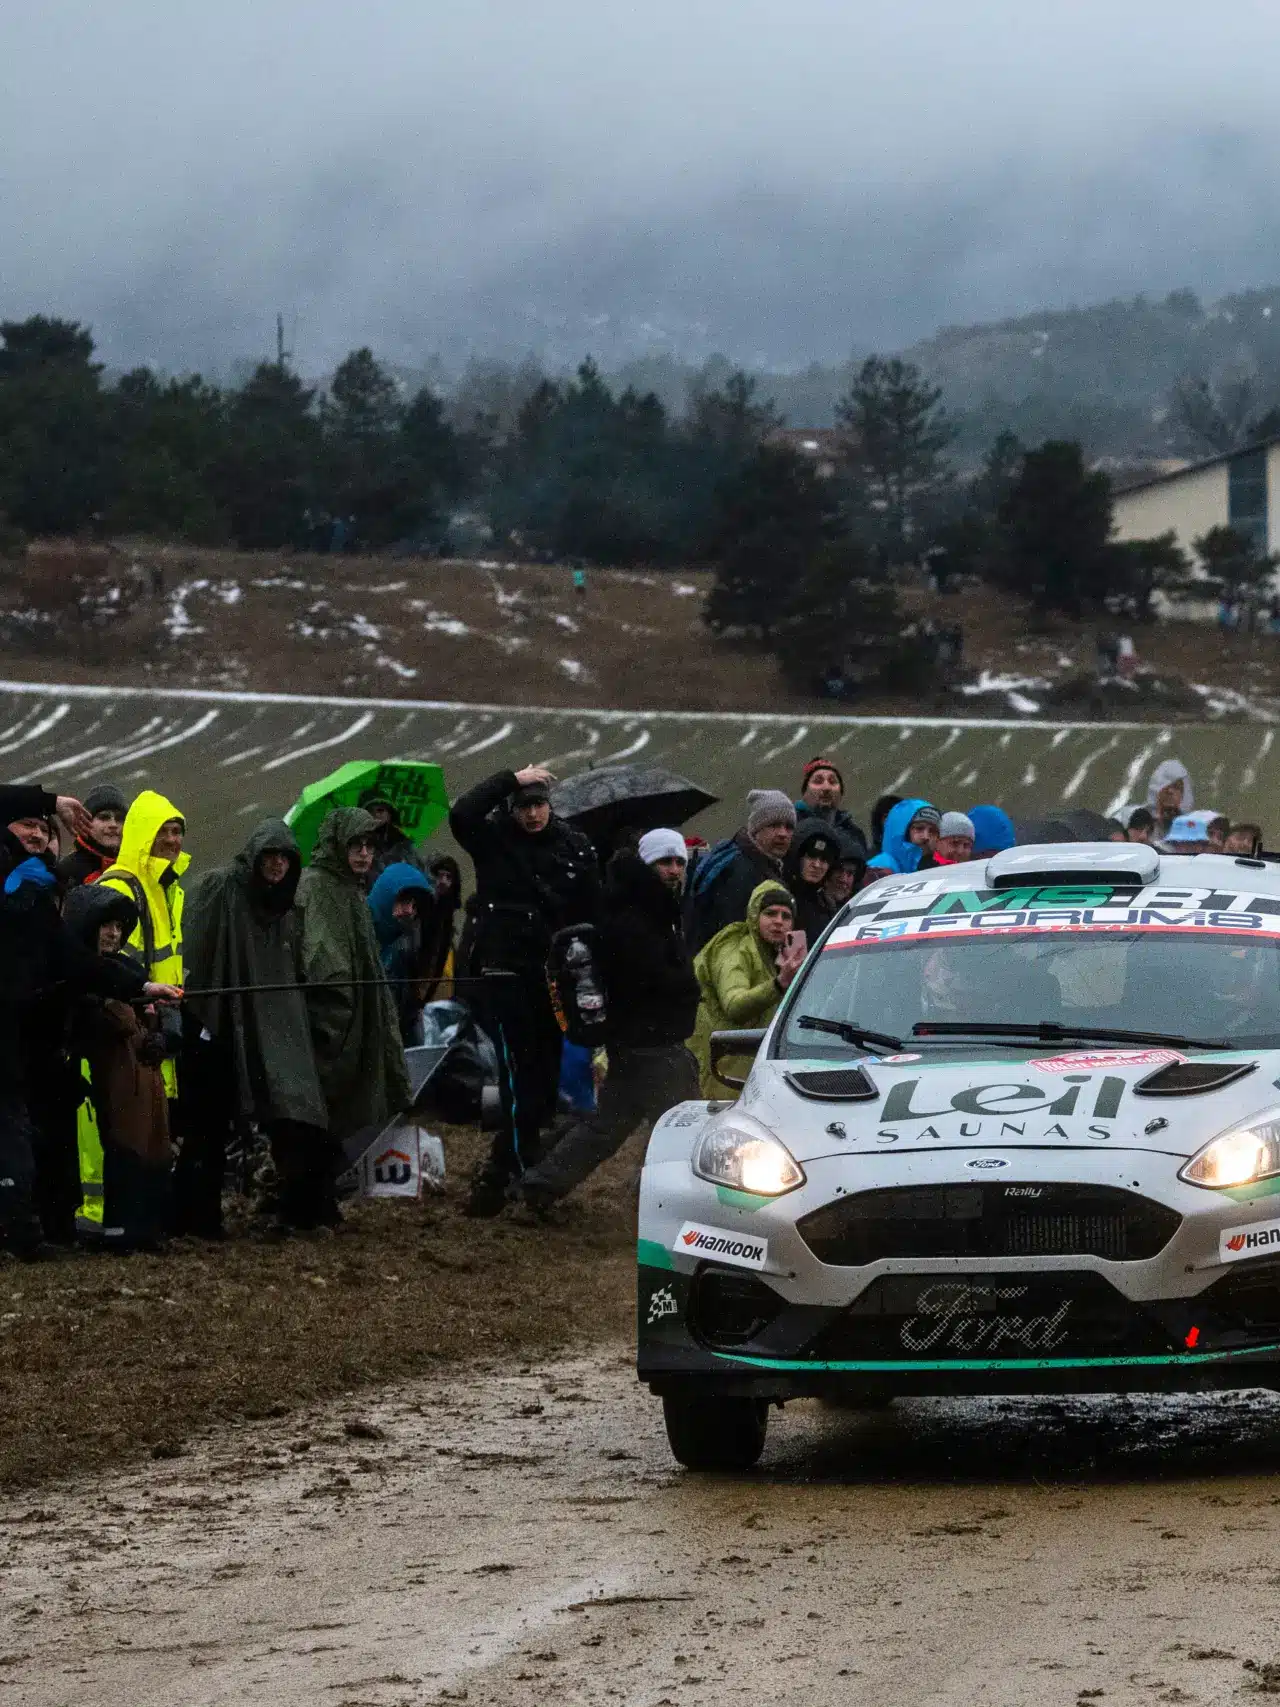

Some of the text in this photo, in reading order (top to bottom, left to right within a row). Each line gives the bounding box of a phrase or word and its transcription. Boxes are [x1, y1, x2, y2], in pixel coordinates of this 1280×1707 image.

[880, 881, 929, 898] 24
[918, 909, 1264, 932] FORUM8
[880, 1075, 1126, 1123] Leil
[876, 1122, 1111, 1144] SAUNAS
[1004, 1187, 1042, 1198] Rally
[900, 1283, 1074, 1351] Ford
